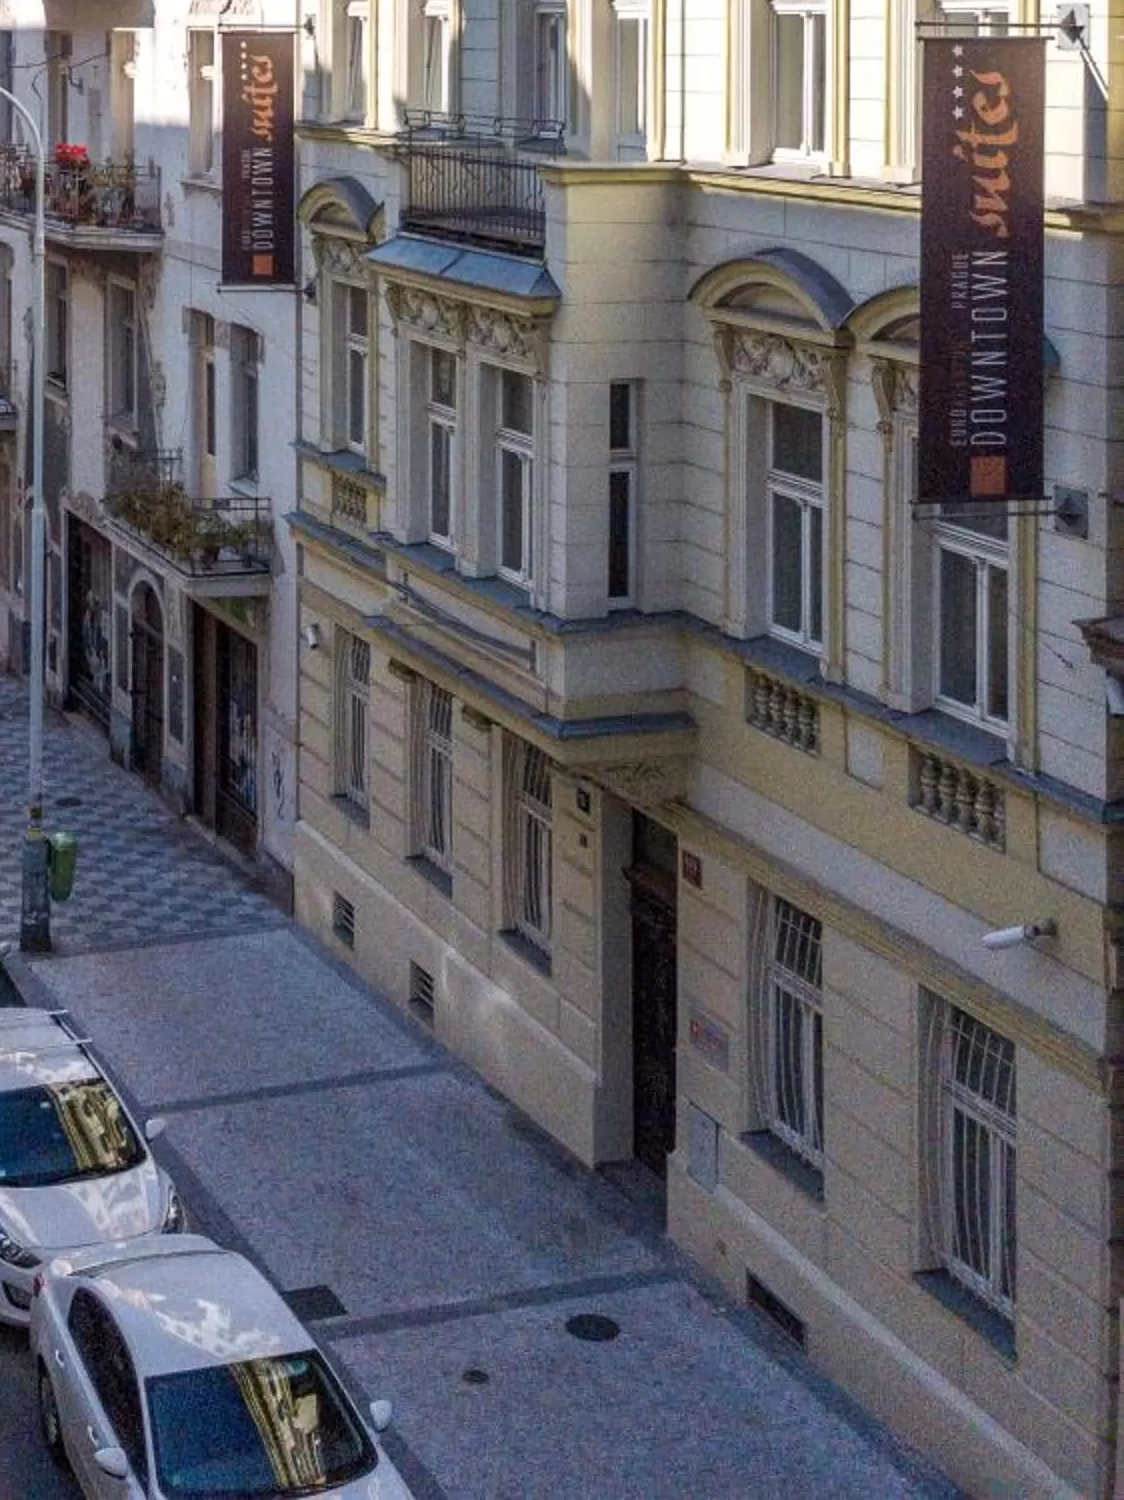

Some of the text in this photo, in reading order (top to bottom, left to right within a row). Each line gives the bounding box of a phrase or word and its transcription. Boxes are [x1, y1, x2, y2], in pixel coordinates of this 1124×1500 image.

[242, 54, 278, 250] DOWNTOWN suites
[951, 252, 968, 309] PRAGUE
[953, 69, 1018, 446] DOWNTOWN suites
